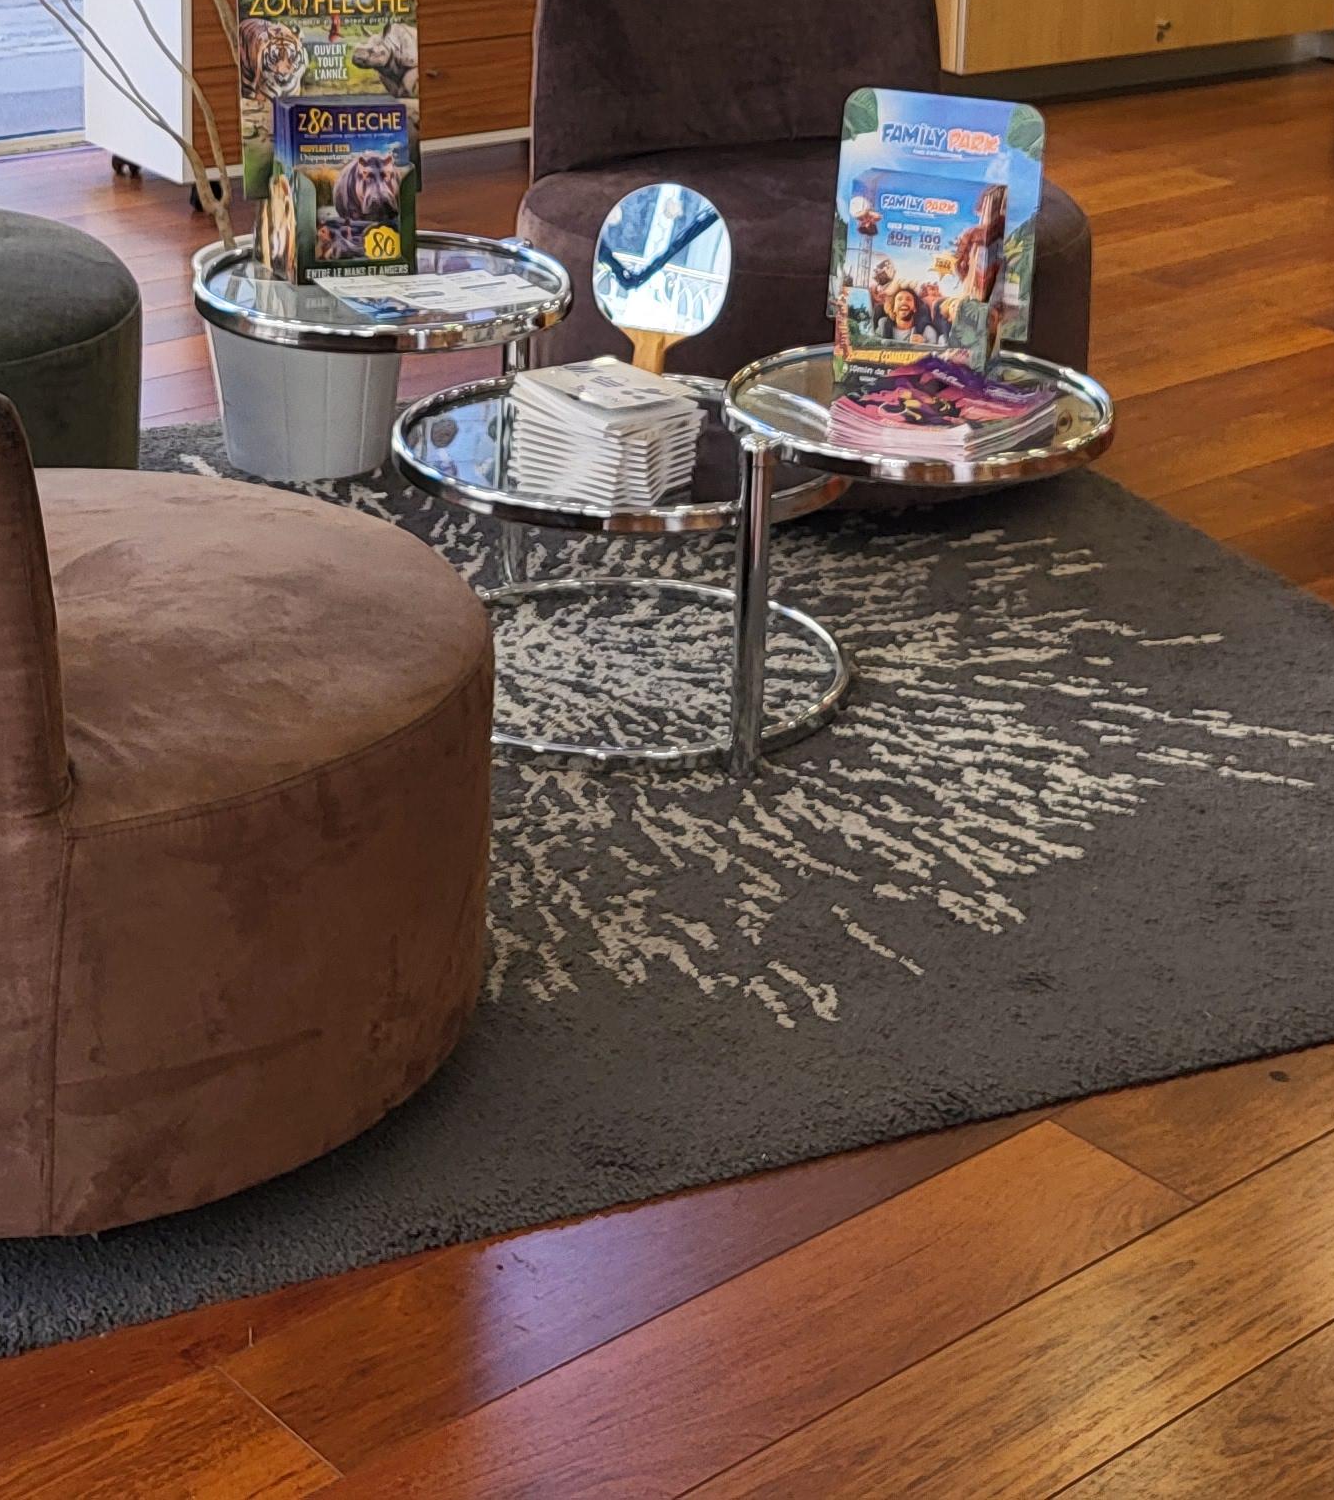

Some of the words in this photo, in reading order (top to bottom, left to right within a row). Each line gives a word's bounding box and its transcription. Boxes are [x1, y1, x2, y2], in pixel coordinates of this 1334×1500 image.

[313, 43, 347, 56] OUVERT
[317, 56, 344, 68] TOUTE
[947, 128, 1001, 154] PARK
[881, 194, 925, 212] FAMILY
[923, 198, 958, 214] PARK
[305, 268, 332, 280] ENTRE
[333, 267, 343, 278] LE
[344, 266, 366, 277] MANS
[368, 265, 378, 276] ET
[379, 263, 409, 276] ANGERS
